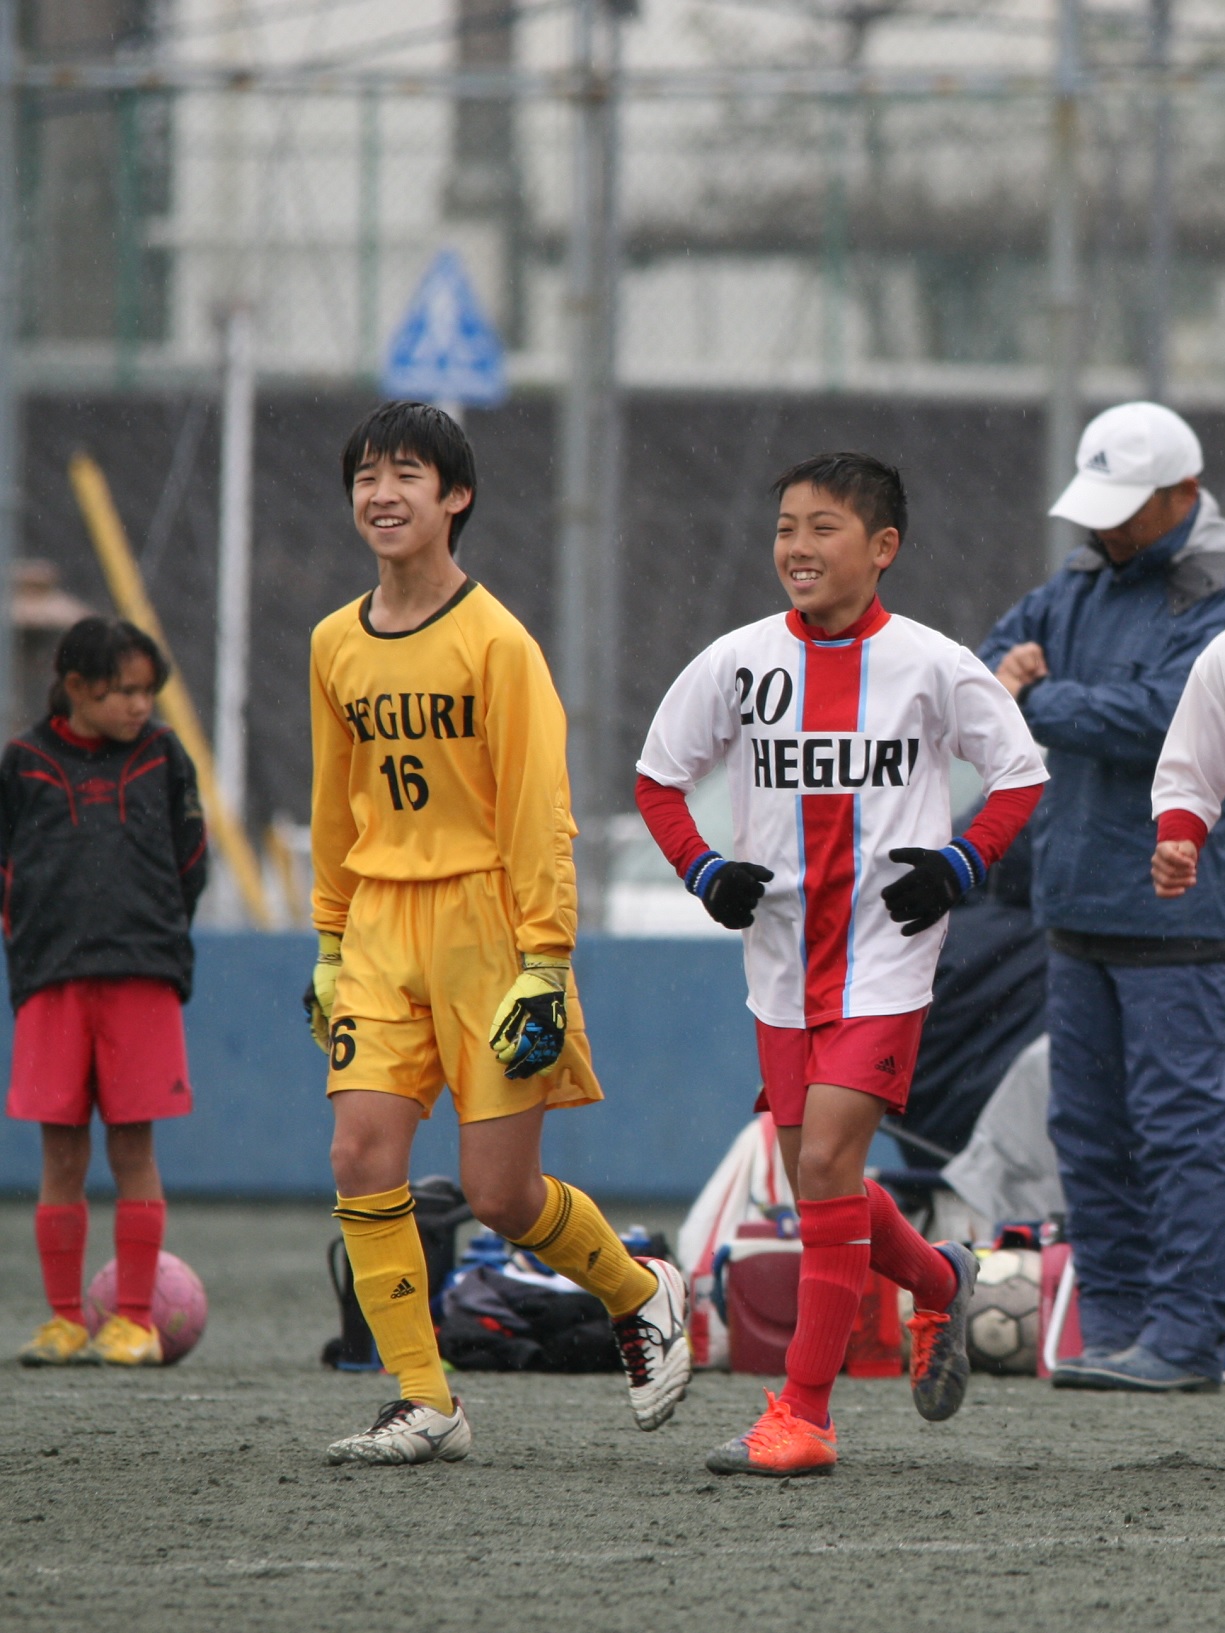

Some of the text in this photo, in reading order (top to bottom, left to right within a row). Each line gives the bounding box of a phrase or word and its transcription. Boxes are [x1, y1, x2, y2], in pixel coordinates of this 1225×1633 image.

[735, 667, 793, 725] 20
[379, 754, 429, 811] 16
[751, 738, 919, 789] HEGURI
